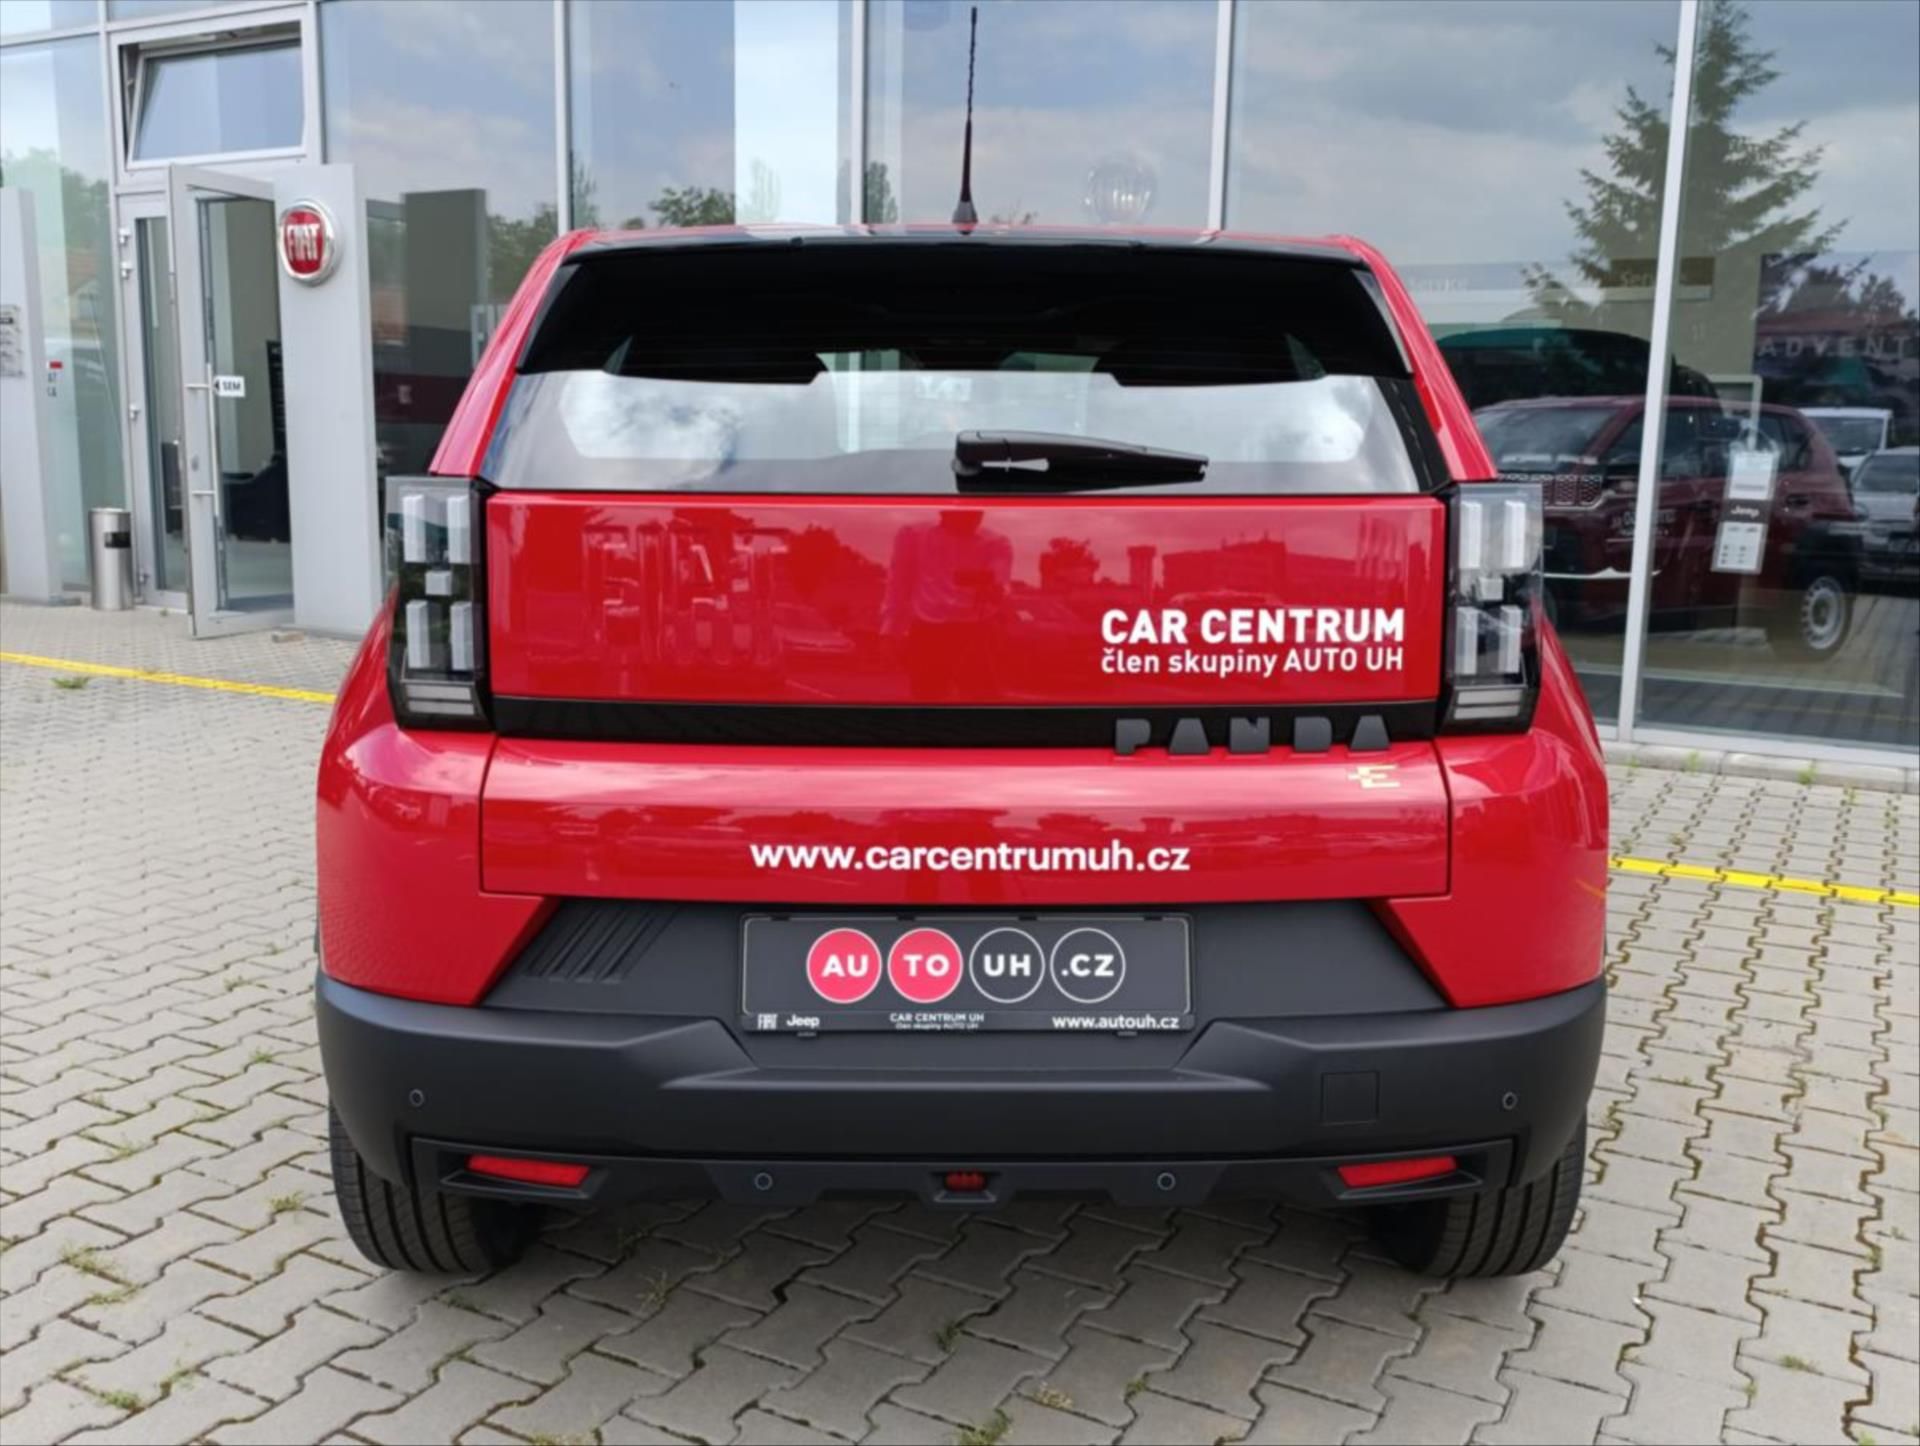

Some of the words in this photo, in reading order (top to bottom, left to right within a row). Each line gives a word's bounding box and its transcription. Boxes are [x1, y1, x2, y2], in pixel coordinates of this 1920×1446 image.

[286, 223, 321, 262] FIAT
[1101, 608, 1189, 645] CAR
[1200, 607, 1405, 644] CENTRUM
[1101, 647, 1160, 674] člen
[1168, 649, 1278, 679] skupiny
[1283, 648, 1358, 672] AUTO
[1365, 647, 1403, 671] UH
[1113, 714, 1392, 755] PANDA
[749, 840, 1191, 872] www.carcentrumuh.cz
[757, 1013, 779, 1031] FIAT
[786, 1014, 821, 1029] Jeep
[889, 1012, 913, 1023] CAR
[914, 1012, 967, 1023] CENTRUM
[968, 1012, 985, 1023] UH
[1052, 1015, 1180, 1030] www.autouh.cz
